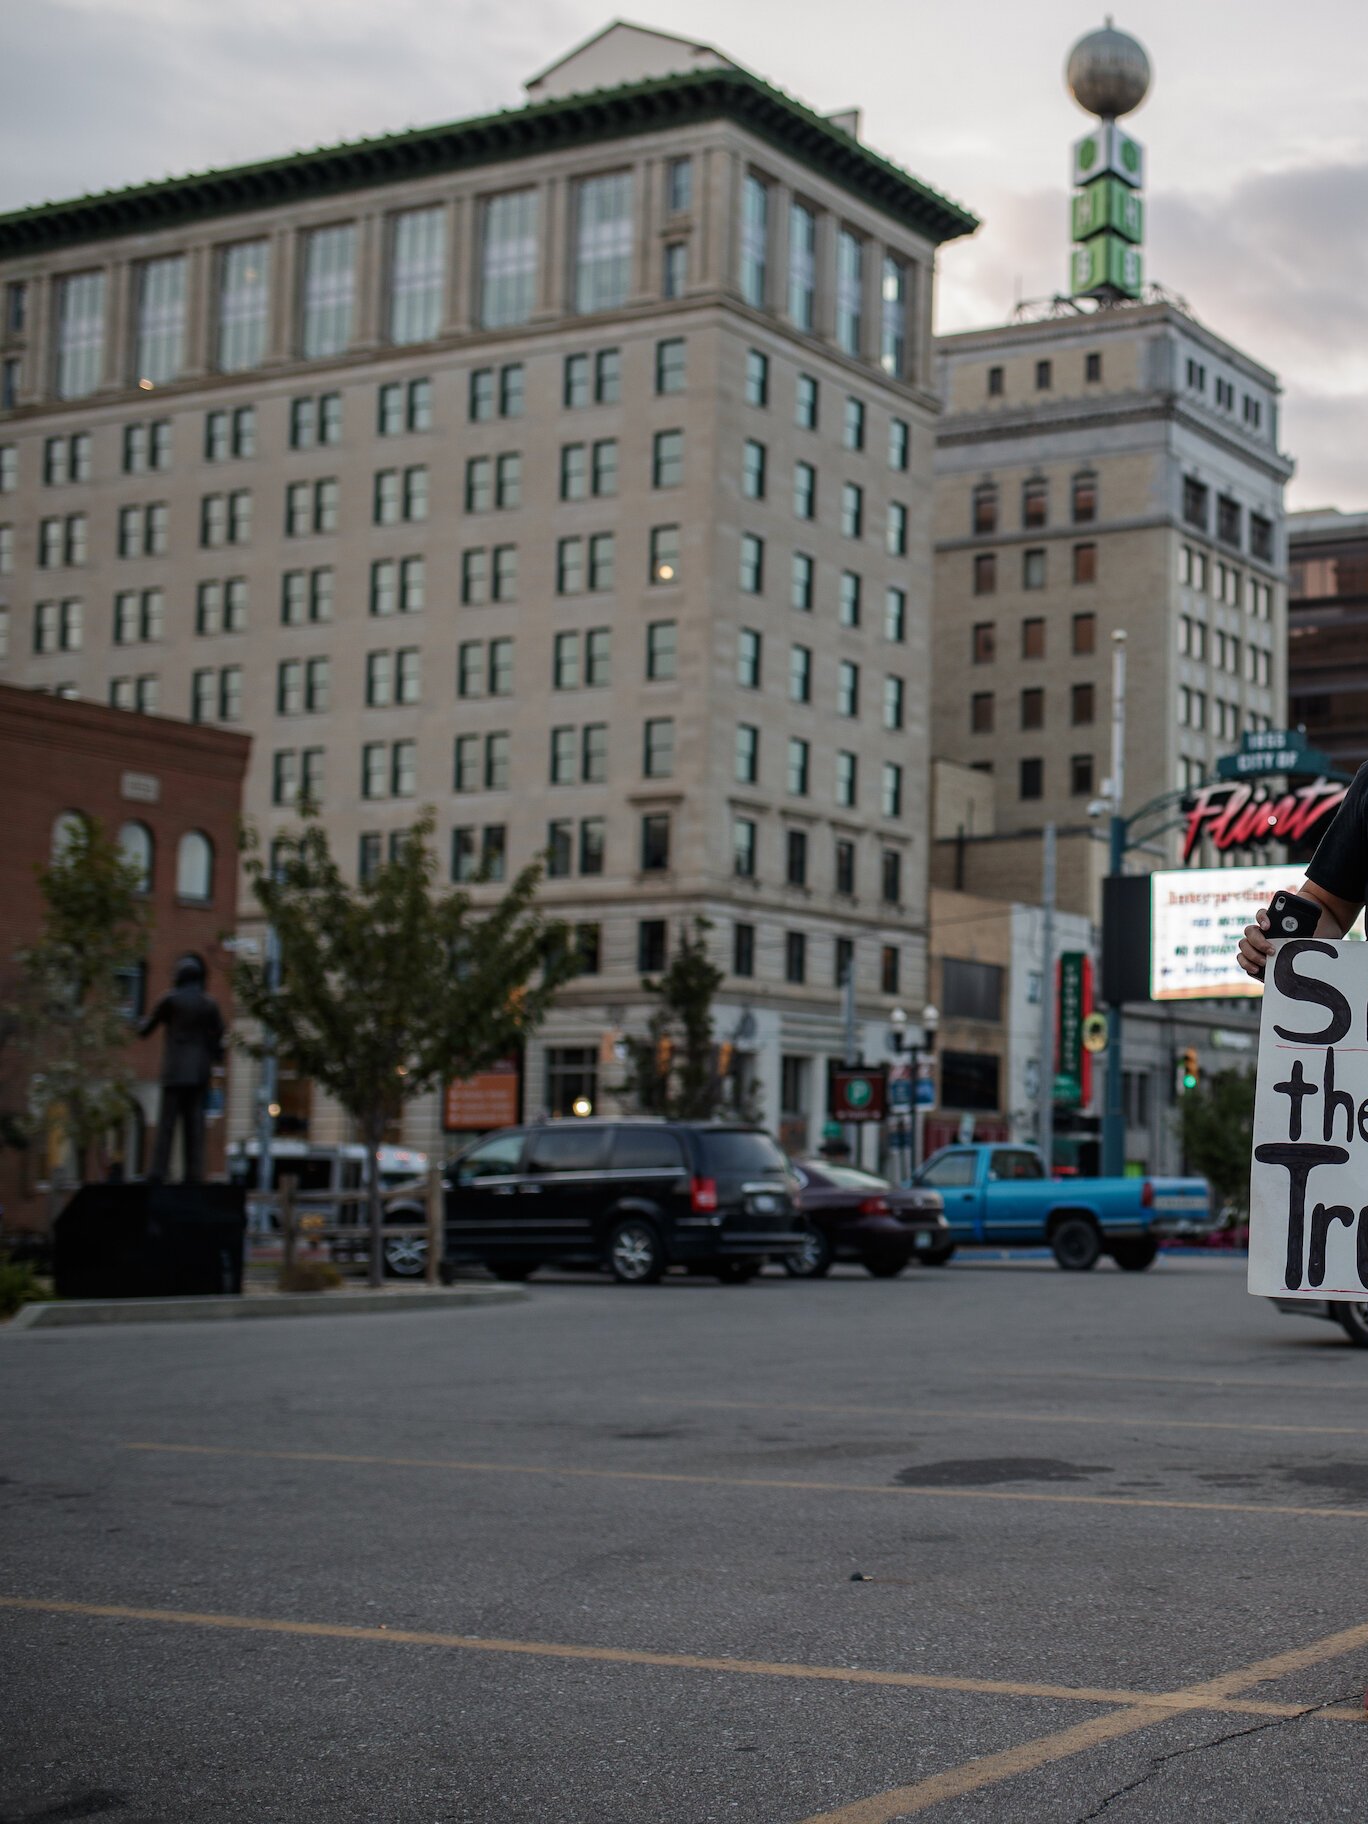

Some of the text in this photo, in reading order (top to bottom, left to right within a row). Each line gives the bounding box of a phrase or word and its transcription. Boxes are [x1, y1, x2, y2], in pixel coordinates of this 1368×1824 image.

[1237, 750, 1297, 771] CITY OF
[1184, 777, 1350, 864] Flint
